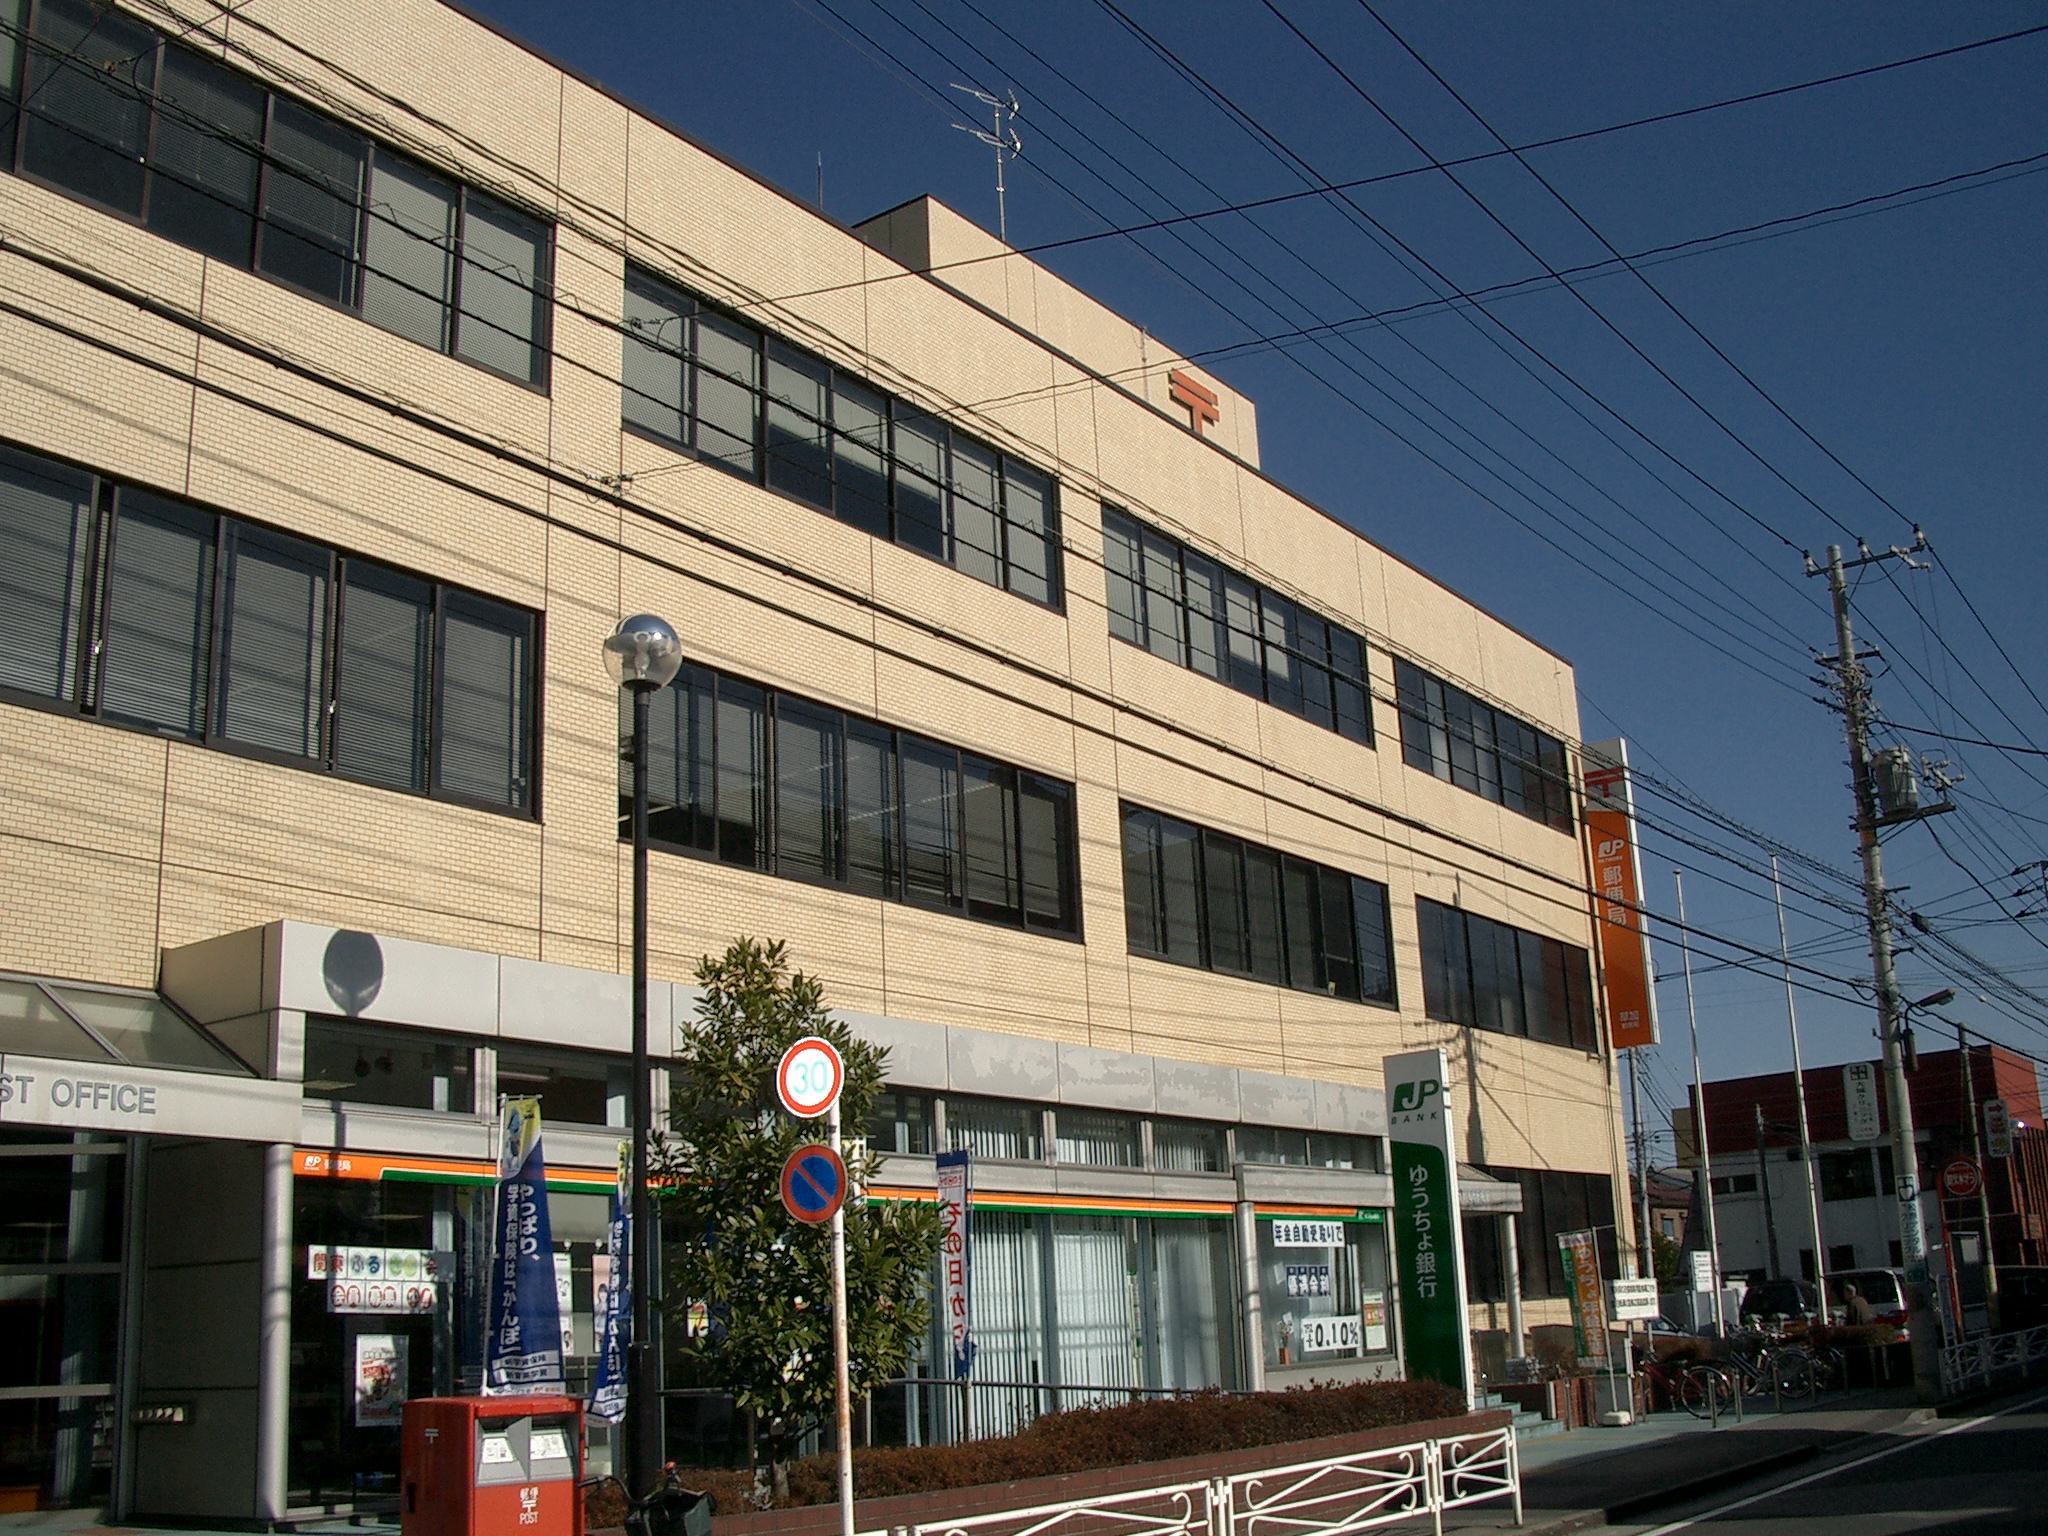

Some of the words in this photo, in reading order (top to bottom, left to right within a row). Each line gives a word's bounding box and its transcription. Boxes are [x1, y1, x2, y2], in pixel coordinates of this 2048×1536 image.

[1602, 865, 1627, 928] 郵便局
[0, 1073, 34, 1104] ST
[51, 1078, 156, 1115] OFFICE
[793, 1060, 828, 1096] 30
[1392, 1079, 1439, 1113] JP
[1391, 1111, 1437, 1125] BANK
[1408, 1164, 1438, 1299] ゆうちょ銀行
[1315, 1321, 1359, 1347] 0.10%
[519, 1511, 539, 1525] POST
